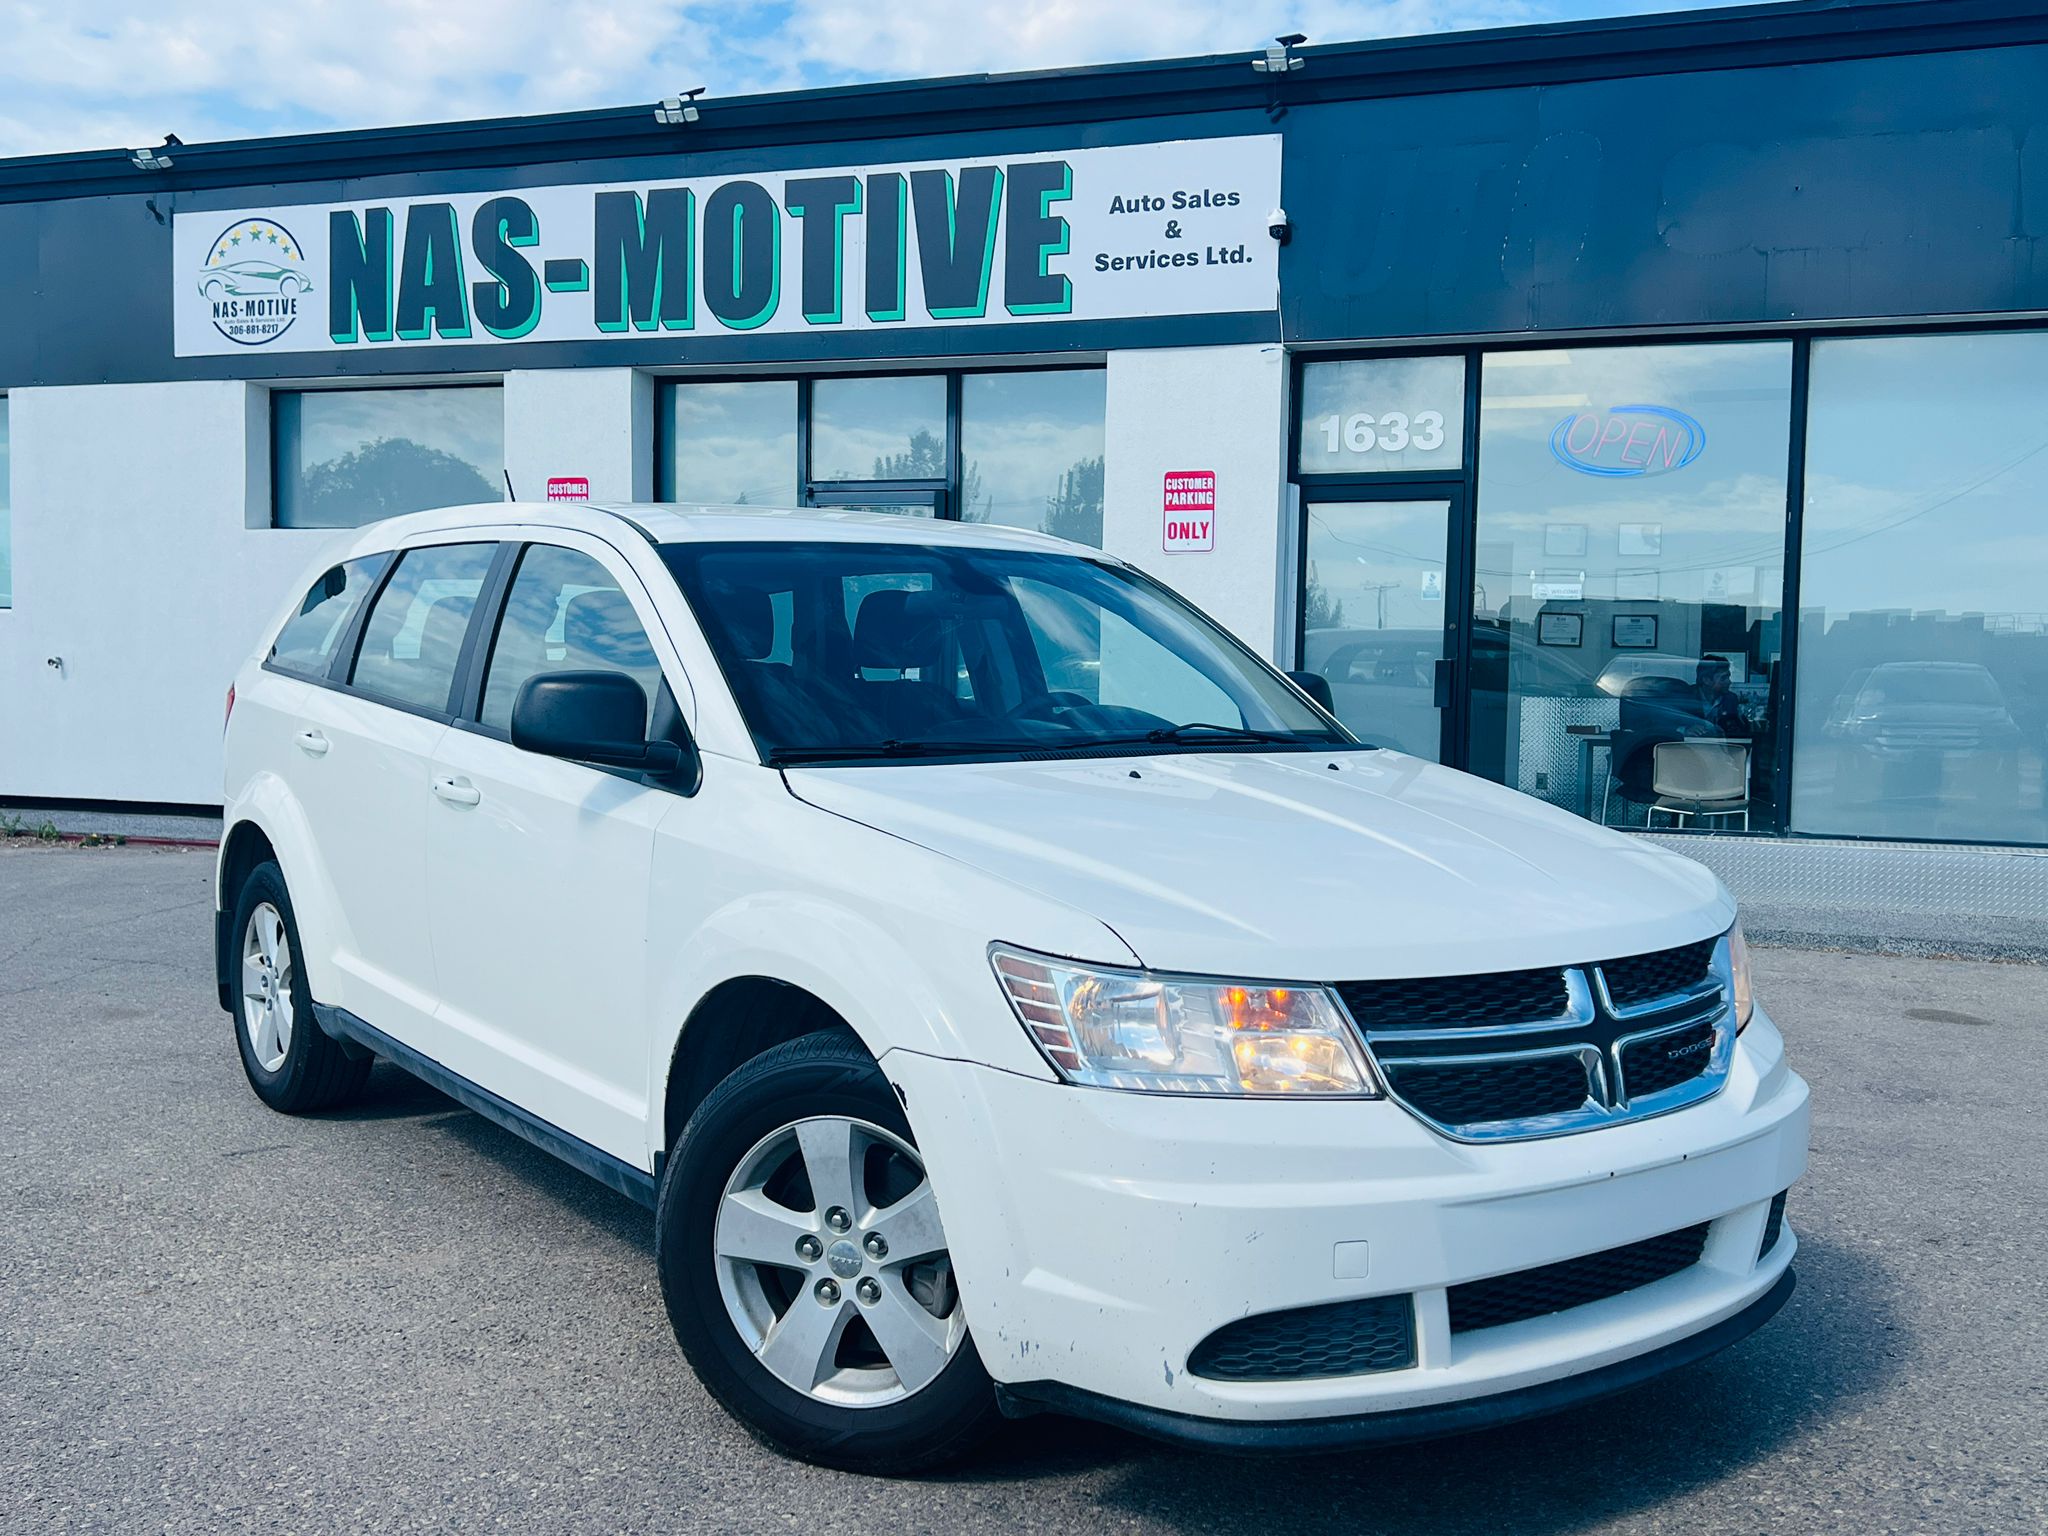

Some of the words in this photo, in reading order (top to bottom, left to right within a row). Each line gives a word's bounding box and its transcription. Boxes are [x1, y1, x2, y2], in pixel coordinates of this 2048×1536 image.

[1109, 195, 1166, 215] Auto
[1172, 188, 1241, 210] Sales
[1164, 219, 1183, 239] &
[329, 160, 1073, 345] NAS-MOTIVE
[1094, 249, 1200, 272] Services
[1206, 244, 1253, 265] Ltd.
[213, 299, 296, 318] NAS-MOTIVE
[229, 323, 279, 335] 306-881-8217
[1319, 410, 1445, 453] 1633
[1567, 413, 1683, 468] OPEN
[549, 482, 587, 495] CUSTOMER
[1166, 478, 1213, 490] CUSTOMER
[1166, 491, 1213, 505] PARKING
[1168, 521, 1209, 539] ONLY
